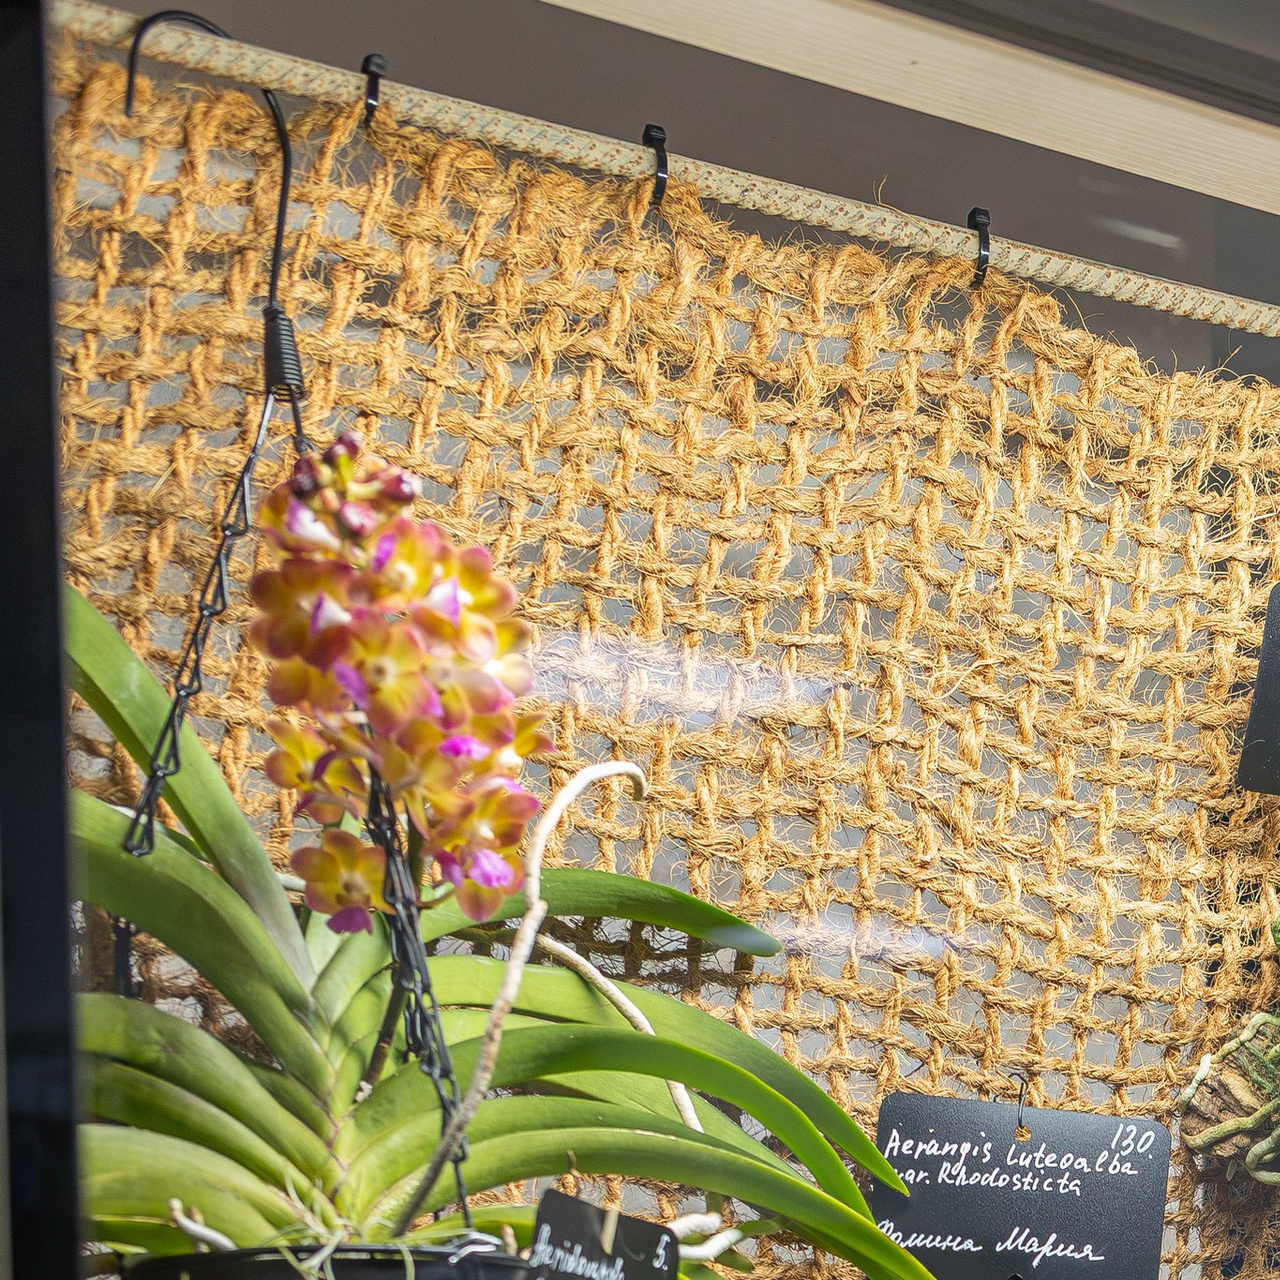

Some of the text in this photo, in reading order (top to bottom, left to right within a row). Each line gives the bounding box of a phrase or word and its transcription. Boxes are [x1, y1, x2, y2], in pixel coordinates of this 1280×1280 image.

[883, 1128, 992, 1172] Aerangis
[937, 1162, 1082, 1197] Rhodosticta
[996, 1226, 1105, 1269] Мария
